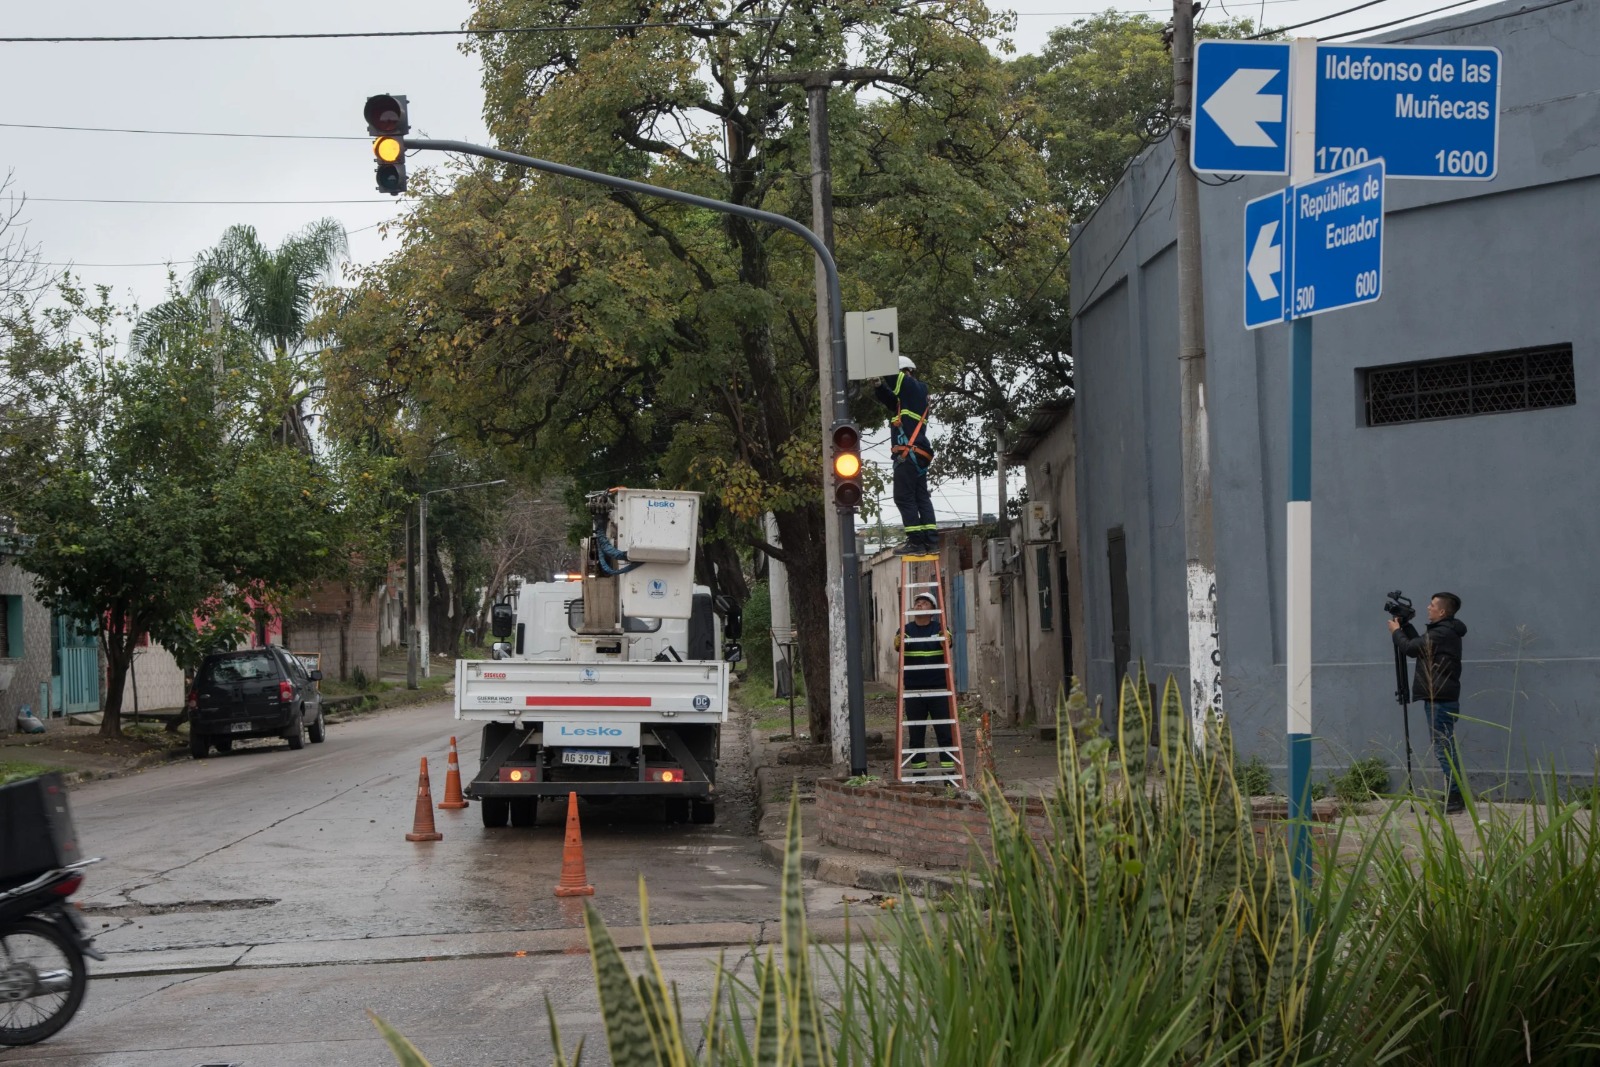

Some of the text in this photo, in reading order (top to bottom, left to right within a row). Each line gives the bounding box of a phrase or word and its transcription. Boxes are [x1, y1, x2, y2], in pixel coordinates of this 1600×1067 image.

[1326, 55, 1491, 83] Ildefonso de las
[1395, 93, 1489, 119] Muñecas
[1317, 147, 1487, 174] 1700 1600
[1300, 174, 1379, 221] República de
[1326, 215, 1379, 249] Ecuador
[1296, 270, 1377, 312] 500 600
[696, 698, 708, 706] DC
[561, 726, 622, 736] Lesko
[564, 753, 608, 765] AG 399 EM
